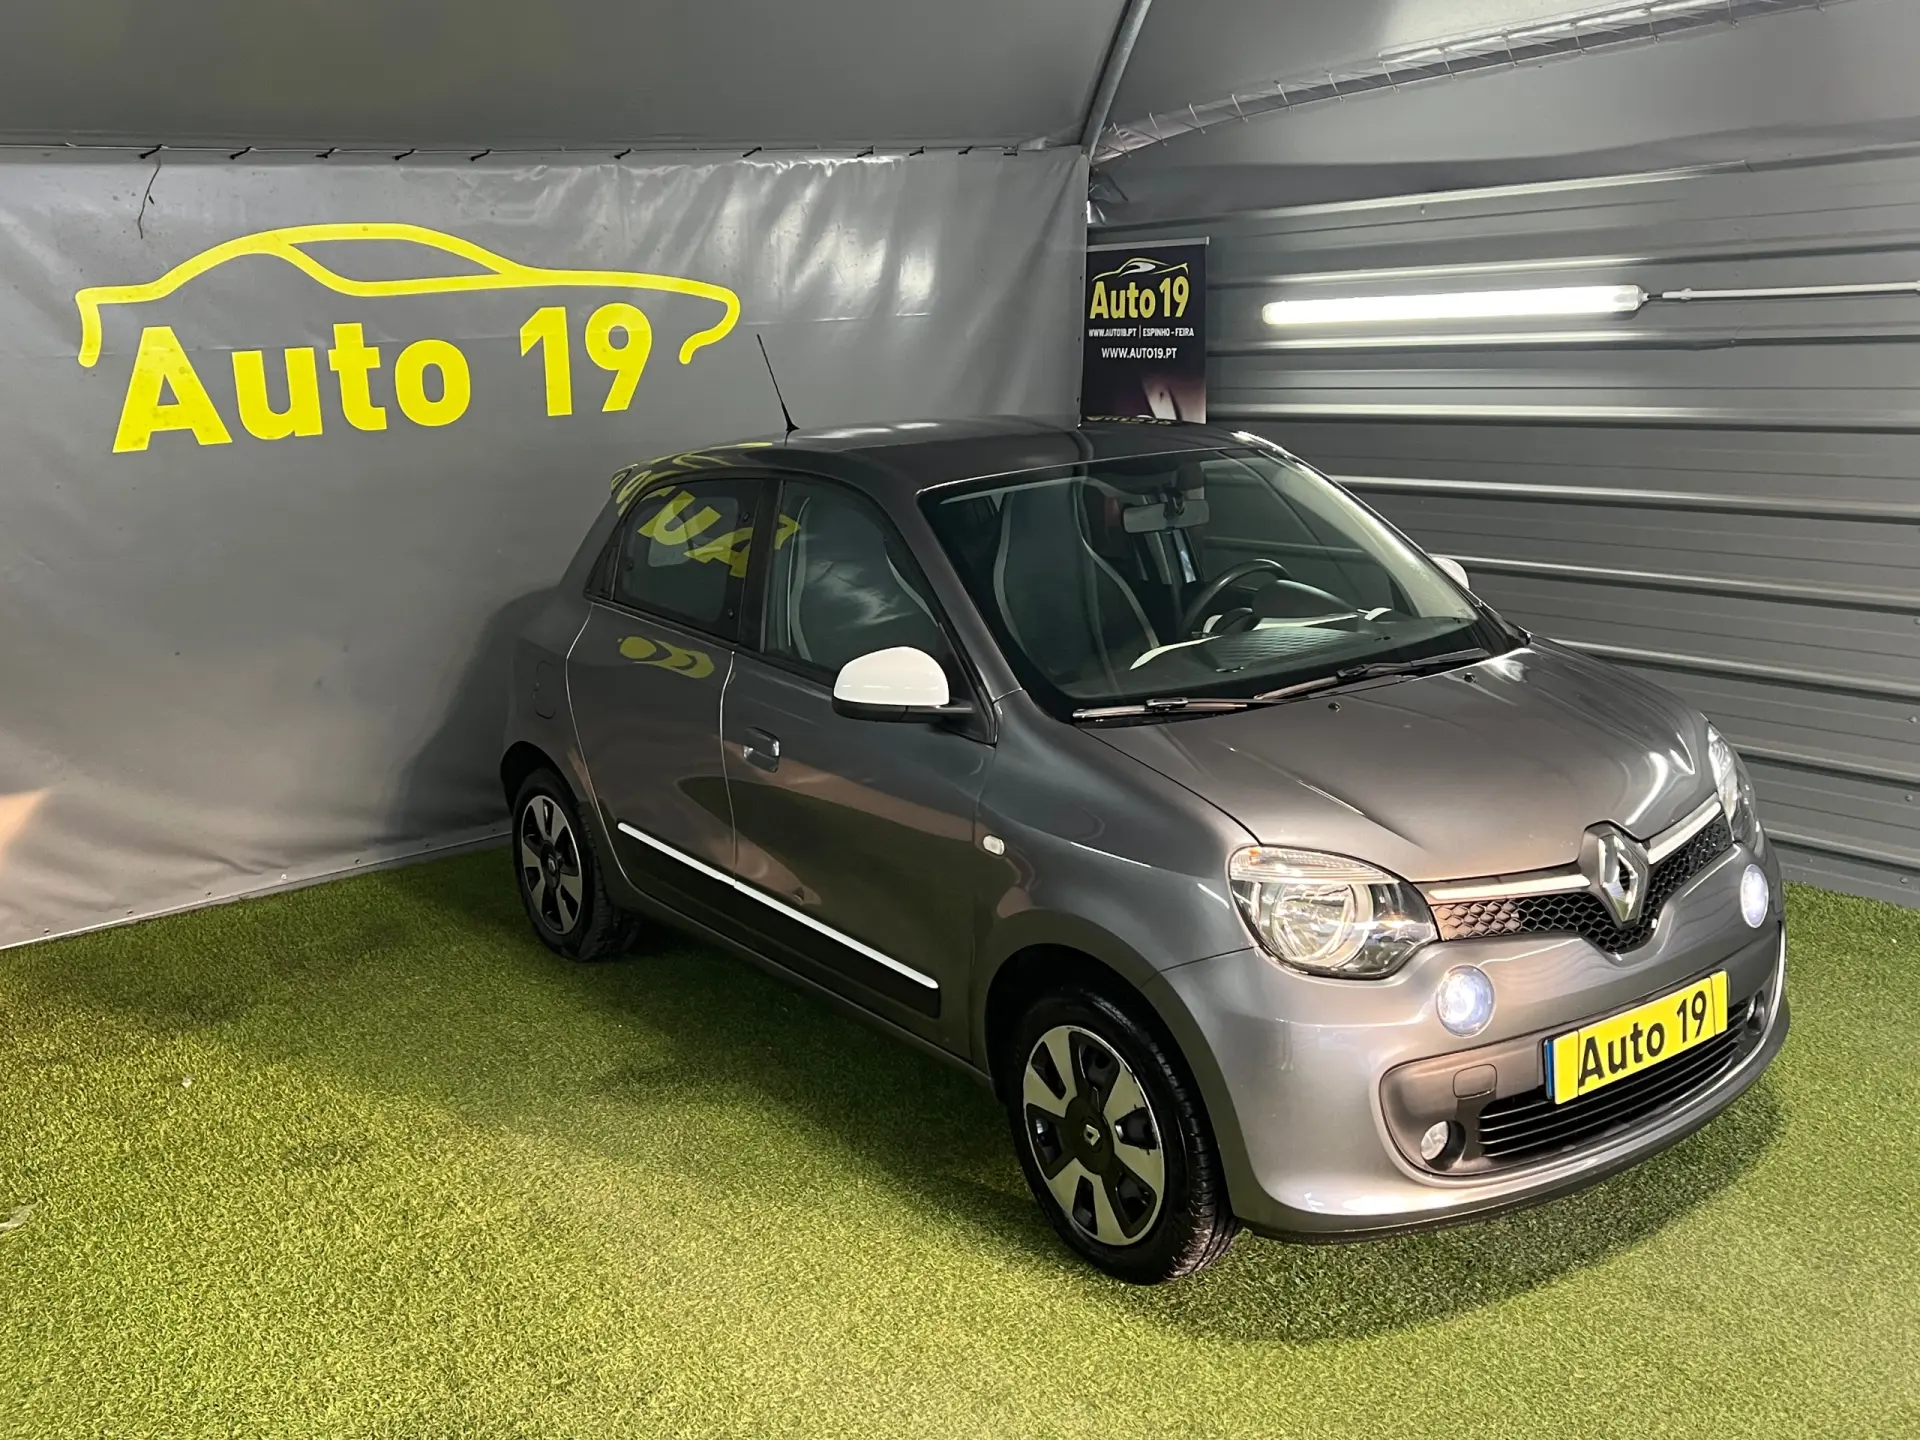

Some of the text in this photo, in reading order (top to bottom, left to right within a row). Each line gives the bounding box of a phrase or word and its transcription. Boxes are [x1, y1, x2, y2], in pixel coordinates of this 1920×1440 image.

[1089, 276, 1190, 319] Auto 19
[1101, 347, 1177, 359] WWW.AUTO19.PT
[1142, 327, 1170, 337] ESPINHO
[1175, 327, 1195, 337] FEIRA
[112, 303, 653, 453] Auto 19
[1578, 990, 1707, 1087] Auto 19
